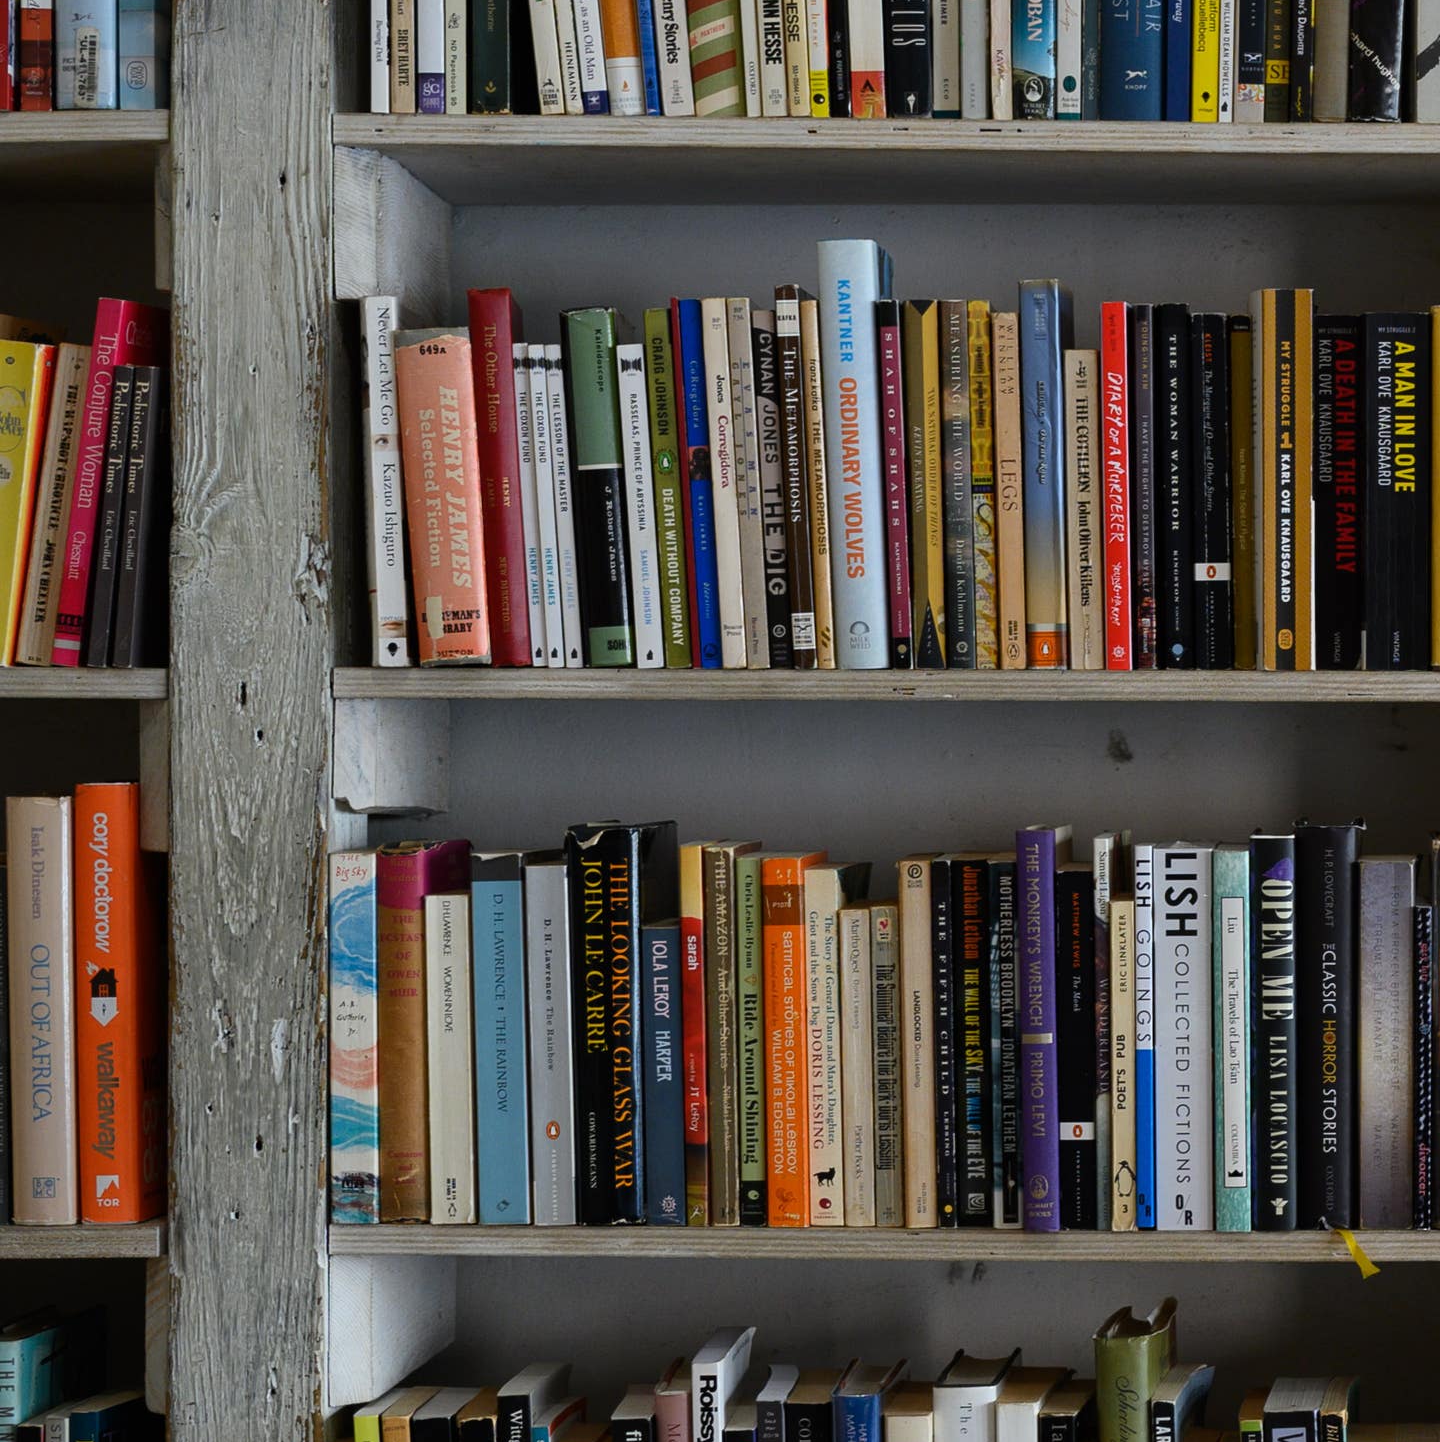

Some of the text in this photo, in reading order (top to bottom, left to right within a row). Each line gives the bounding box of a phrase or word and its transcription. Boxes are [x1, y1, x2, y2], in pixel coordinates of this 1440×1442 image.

[68, 332, 117, 580] The Conjure Woman Chesnutt
[837, 279, 865, 578] KANTNER ORDINARY WOLVES
[1395, 341, 1415, 492] A MAN IN LOVE
[90, 812, 117, 1160] cory doctorow walkaway
[610, 857, 635, 1188] THE LOOKING GLASS WAR
[1164, 852, 1199, 1183] LISH COLLECTED FICTIONS
